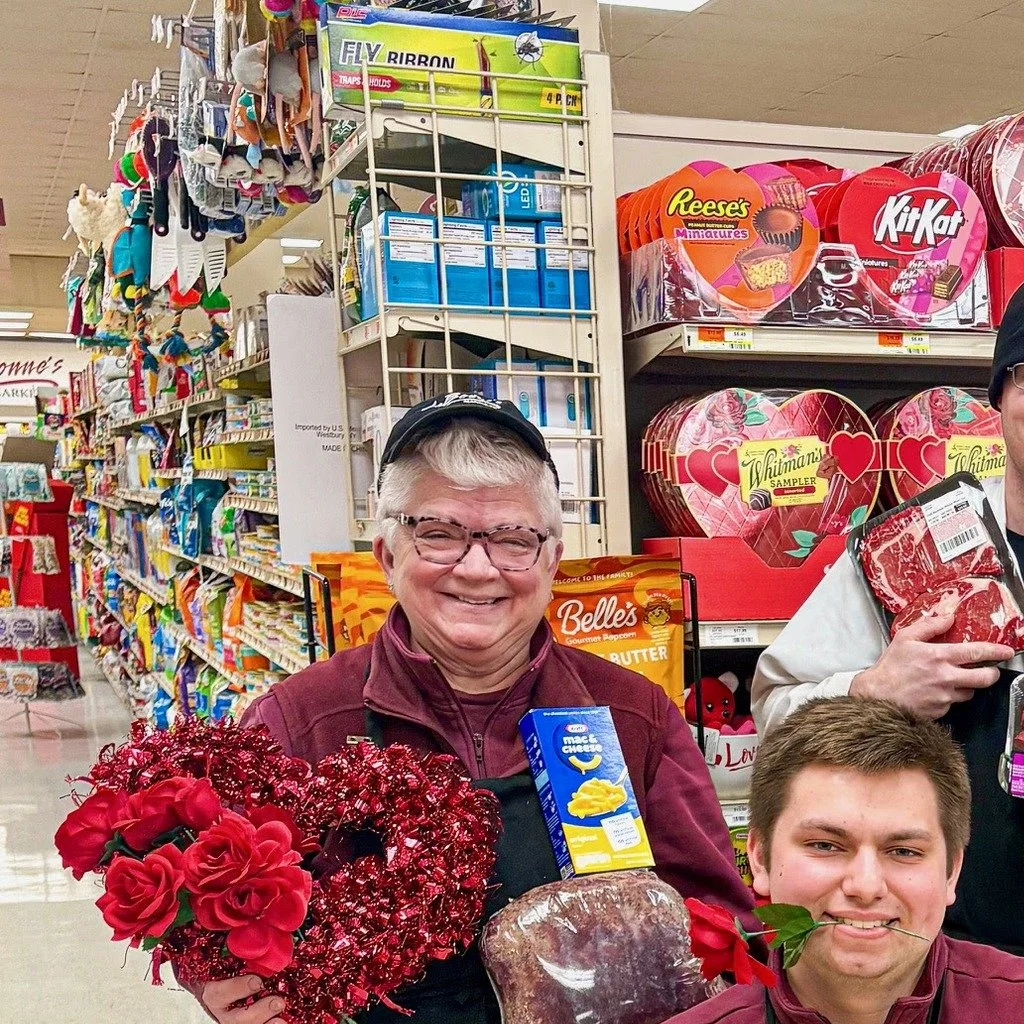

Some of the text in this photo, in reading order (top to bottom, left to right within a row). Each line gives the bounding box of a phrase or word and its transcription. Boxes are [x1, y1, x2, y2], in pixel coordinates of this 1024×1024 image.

[339, 40, 455, 70] FLY RIBBON
[338, 75, 392, 89] TRAPS HOLDS
[546, 94, 578, 107] 4 PCK
[521, 188, 531, 209] LED
[668, 188, 750, 217] Reese's
[675, 229, 748, 239] Miniatures
[741, 448, 823, 490] Whitman's
[948, 445, 1006, 474] Whitma
[770, 477, 817, 488] SAMPLER
[557, 595, 637, 635] Belle's
[566, 632, 637, 645] Gourmet Popcorn
[610, 646, 667, 666] BUTTER
[562, 734, 597, 744] mac &
[725, 742, 756, 767] Lov
